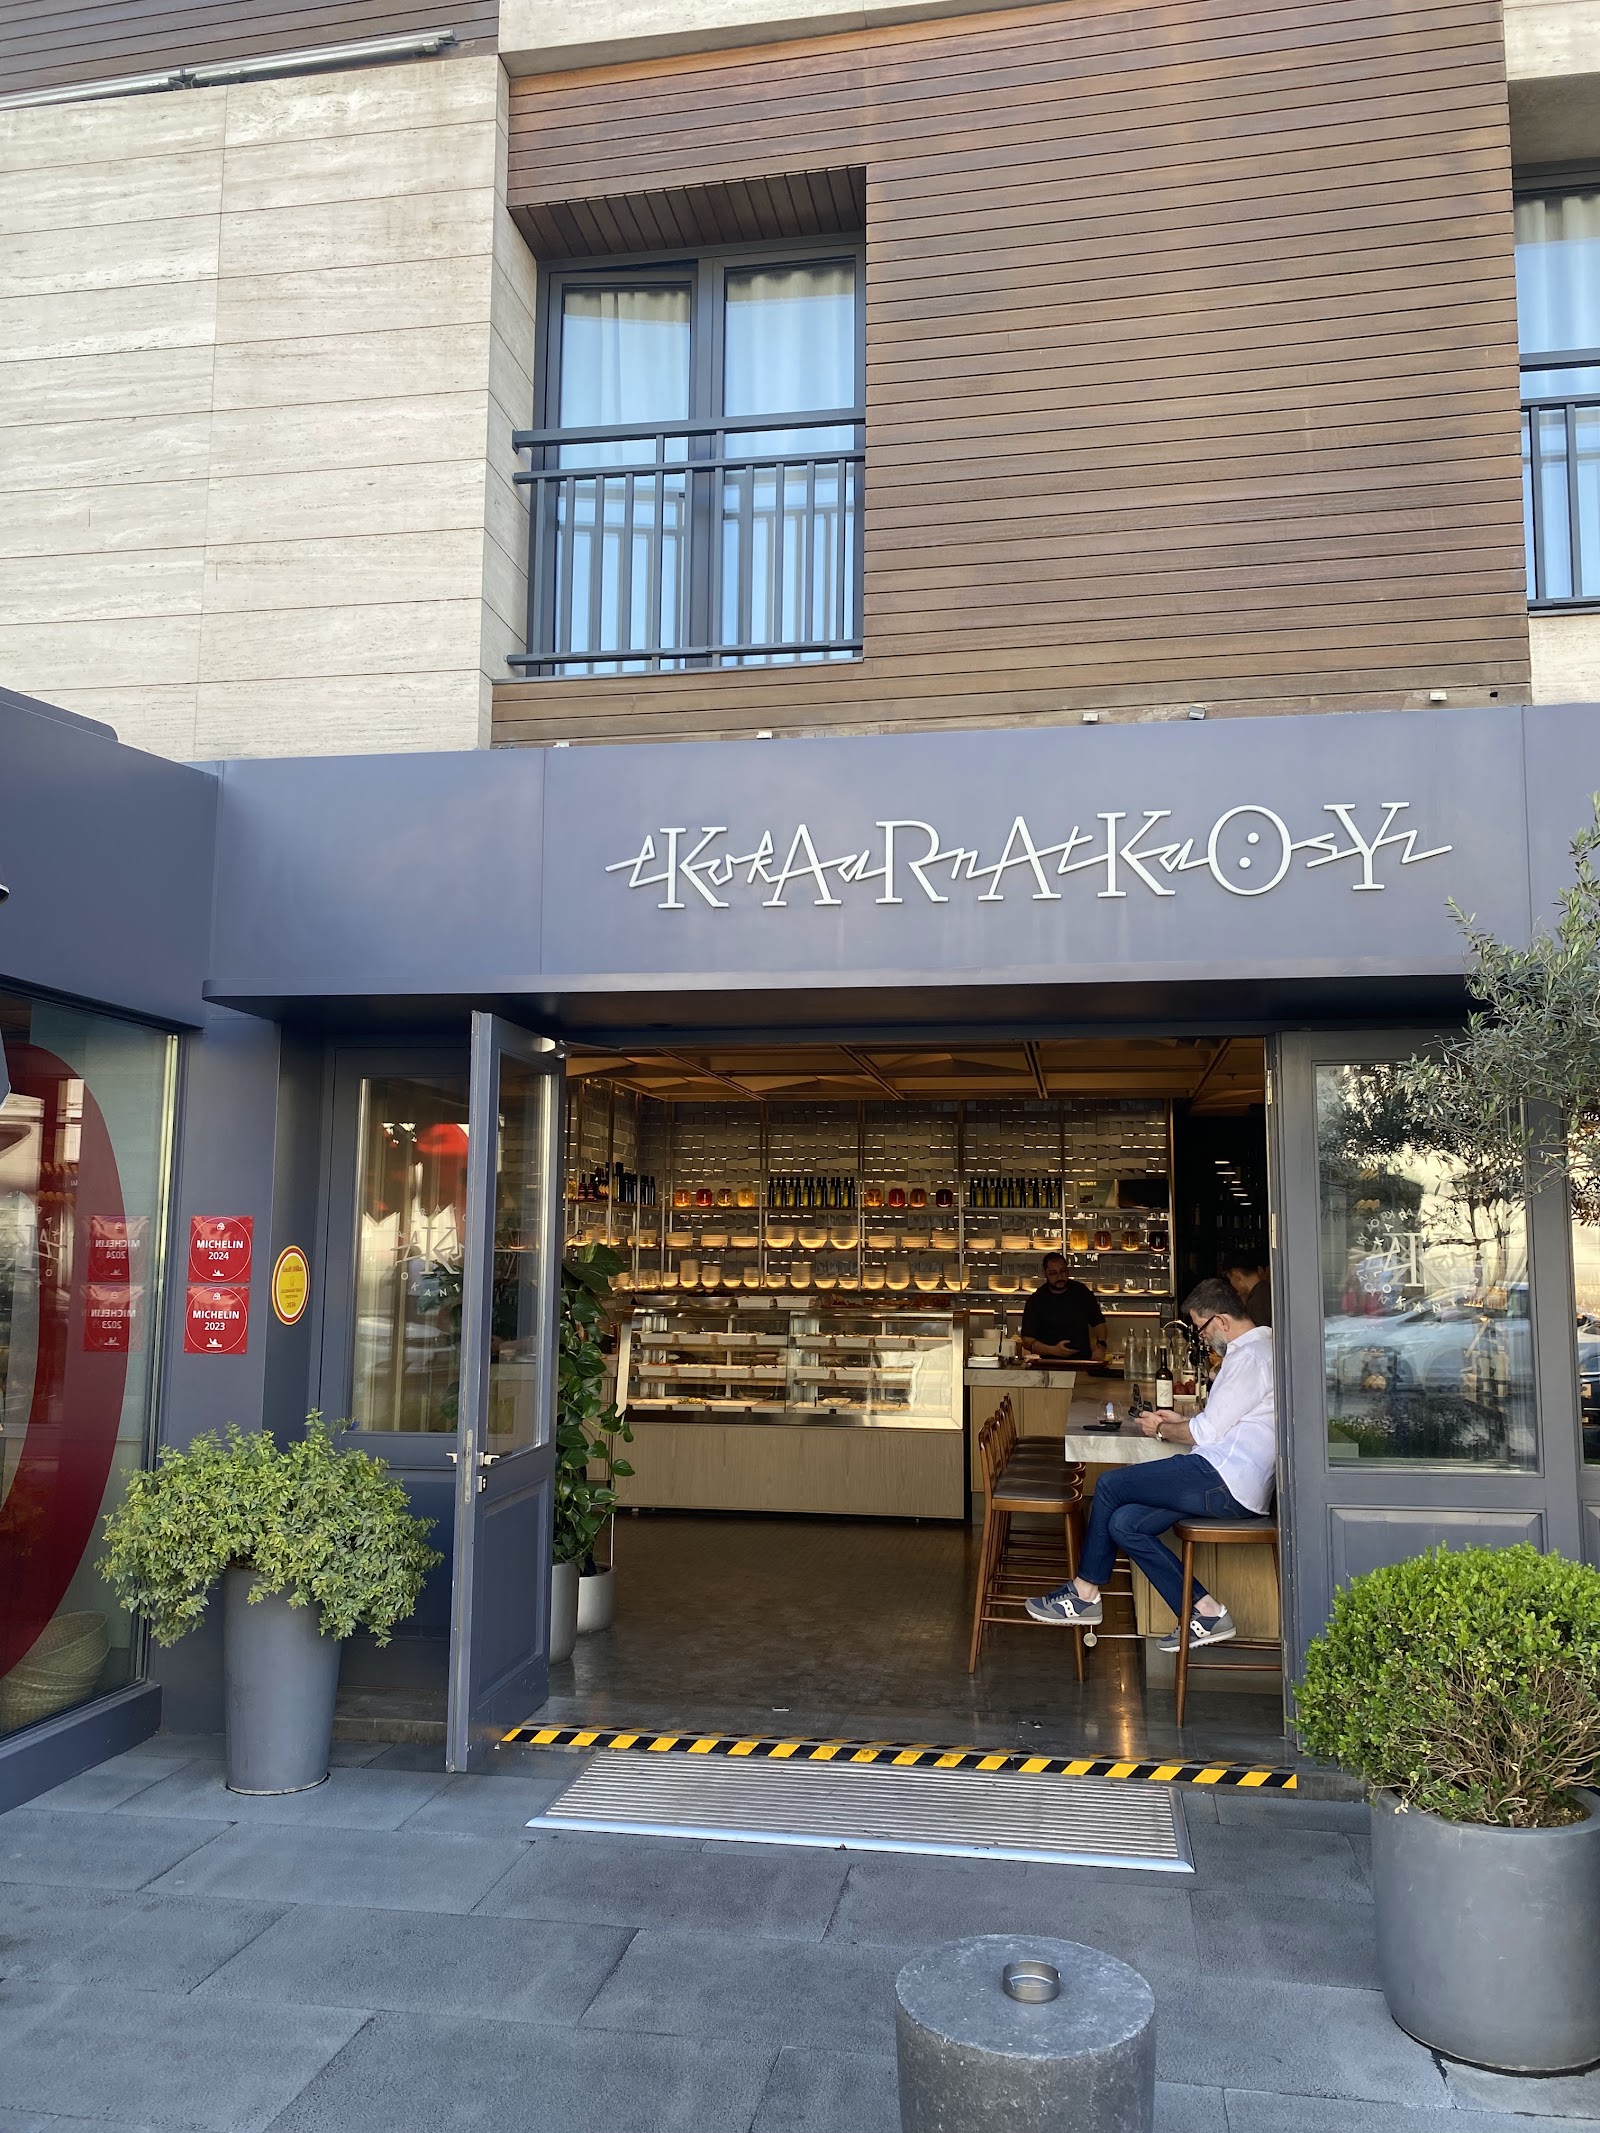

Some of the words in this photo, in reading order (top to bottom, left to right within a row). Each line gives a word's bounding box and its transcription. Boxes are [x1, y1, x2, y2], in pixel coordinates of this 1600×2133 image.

[196, 1240, 244, 1249] MICHELIN
[208, 1251, 230, 1260] 2024
[192, 1310, 240, 1320] MICHELIN
[204, 1322, 226, 1331] 2023
